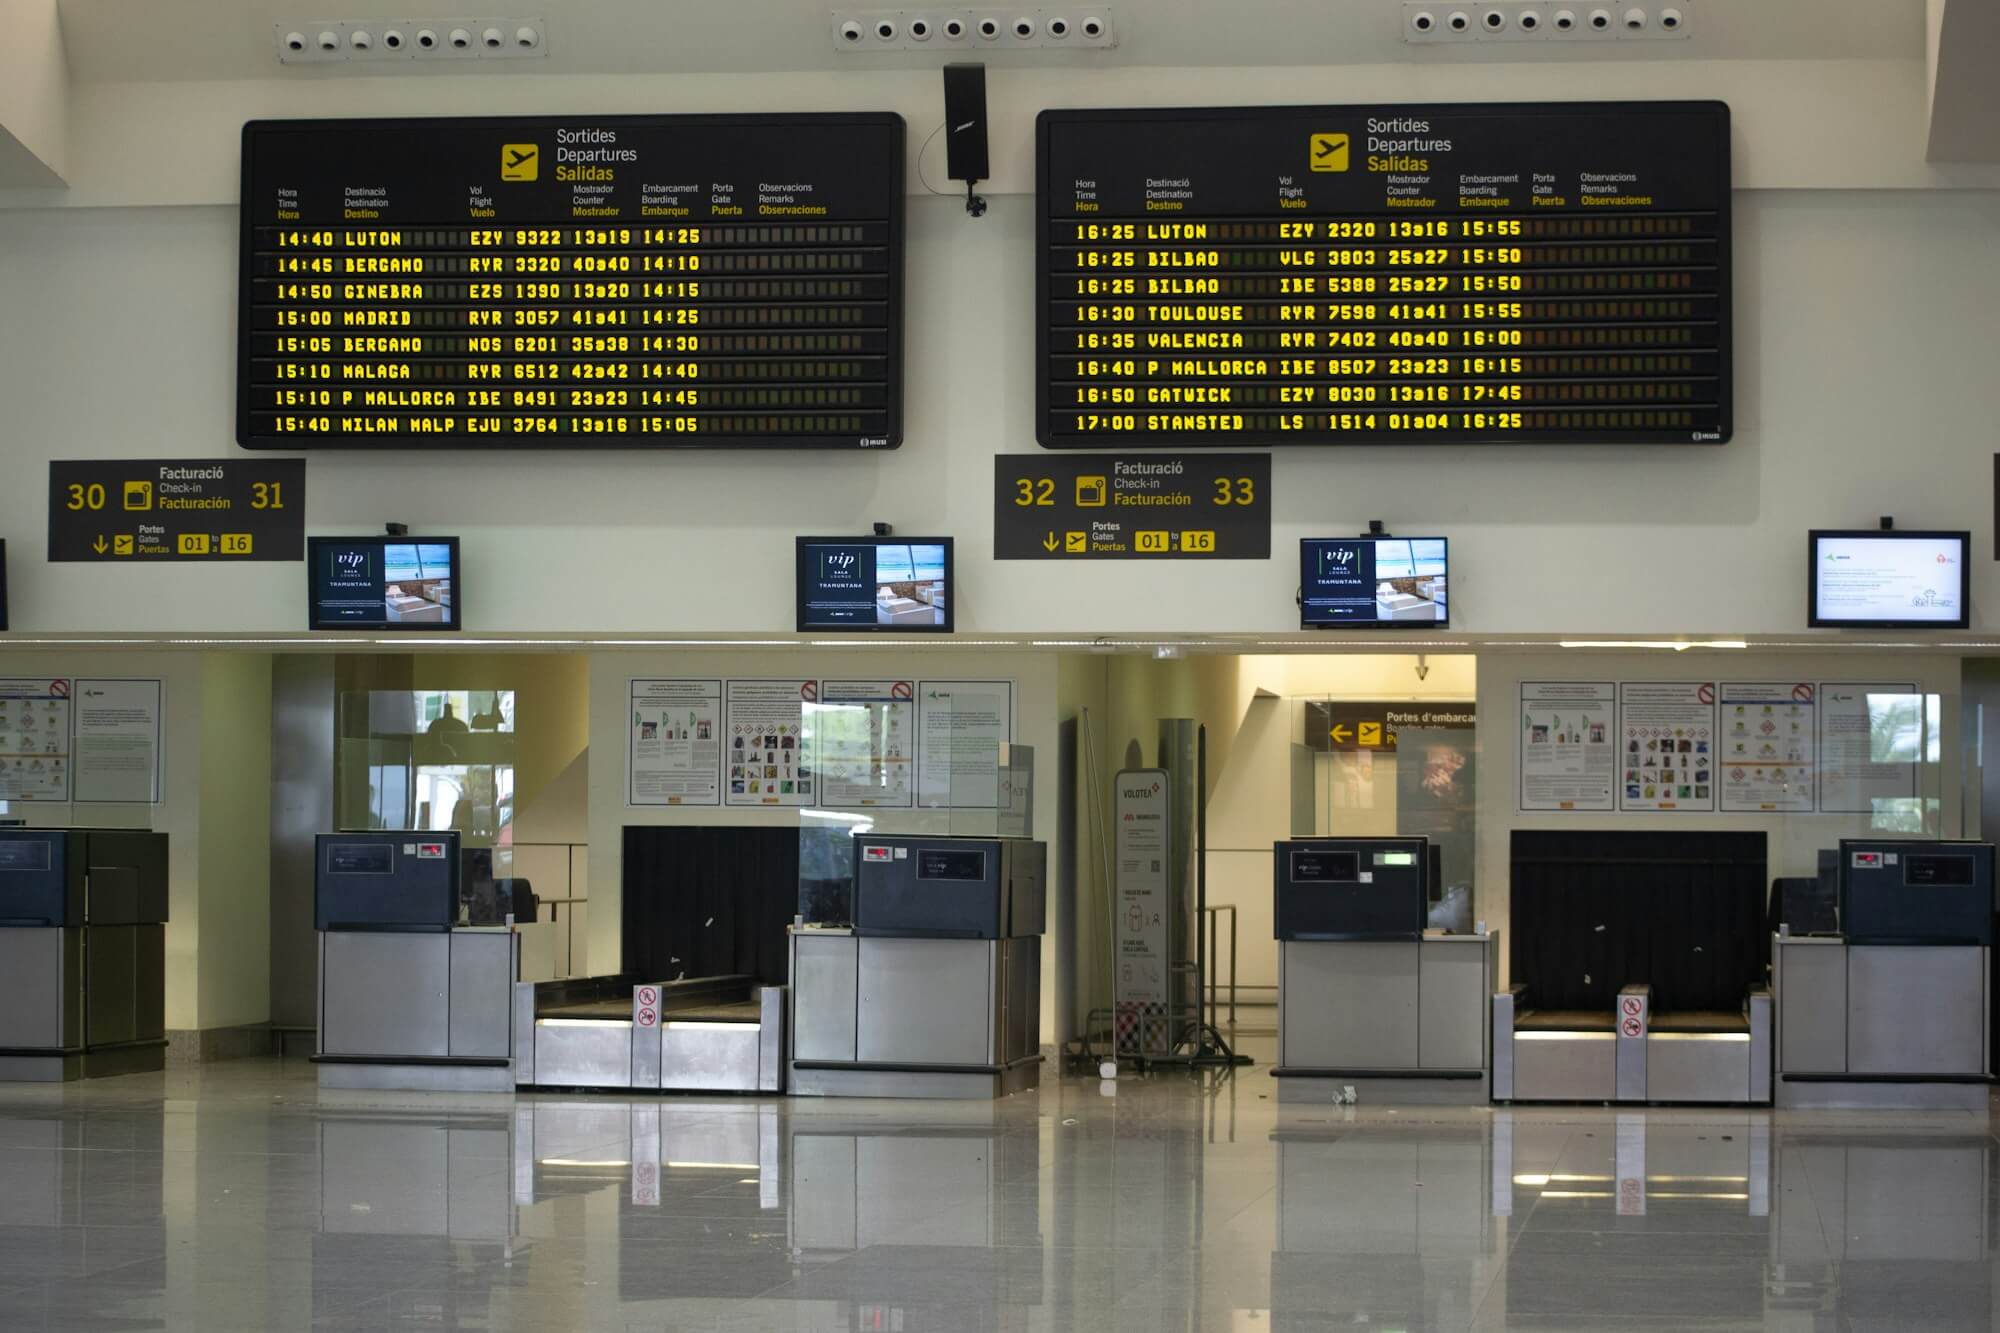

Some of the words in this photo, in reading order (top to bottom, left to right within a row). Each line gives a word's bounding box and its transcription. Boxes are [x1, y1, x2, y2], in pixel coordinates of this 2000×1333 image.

[1368, 118, 1429, 133] Sortides
[557, 129, 616, 143] Sortides
[1368, 137, 1452, 154] Departures
[557, 148, 637, 164] Departures
[1368, 156, 1430, 171] Salidas
[556, 166, 614, 181] Salidas
[345, 187, 386, 197] Destinació
[574, 185, 614, 194] Mostrador
[643, 184, 699, 193] Embarcament
[713, 184, 734, 193] Porta
[759, 183, 813, 192] Observacions
[345, 198, 389, 207] Destination
[573, 196, 604, 205] Counter
[642, 196, 678, 206] Boarding
[759, 194, 794, 203] Remarks
[278, 209, 300, 219] Hora
[345, 209, 379, 218] Destino
[470, 208, 495, 217] Vuelo
[573, 207, 620, 216] Mostrador
[642, 206, 689, 217] Embarque
[712, 205, 743, 215] Puerta
[759, 205, 827, 215] Observaciones
[279, 231, 333, 247] 14:40
[345, 231, 401, 247] LUTON
[470, 230, 503, 246] EZY
[516, 230, 561, 246] 9322
[575, 229, 630, 245] 13a19
[644, 228, 700, 244] 14:25
[1077, 224, 1135, 240] 16:25
[1147, 223, 1207, 240] LUTON
[1279, 223, 1314, 239] EZY
[1328, 222, 1376, 238] 2320
[1389, 221, 1448, 237] 13a16
[1462, 220, 1521, 236] 15:55
[279, 257, 333, 273] 14:45
[345, 257, 423, 273] BERGAMO
[469, 257, 503, 273] RYR
[515, 256, 561, 273] 3320
[573, 256, 630, 272] 40a40
[643, 255, 700, 271] 14:10
[1077, 251, 1135, 267] 16:25
[1148, 251, 1219, 267] BILBAO
[1280, 250, 1315, 266] VLG
[1328, 249, 1376, 266] 3803
[1388, 249, 1449, 265] 25a27
[1462, 248, 1522, 264] 15:50
[278, 284, 332, 299] 14:50
[344, 284, 423, 300] GINEBRA
[469, 283, 503, 299] EZS
[516, 283, 560, 299] 1390
[574, 282, 630, 299] 13a20
[643, 282, 699, 298] 14:15
[1077, 278, 1135, 294] 16:25
[1148, 278, 1219, 294] BILBAO
[1280, 277, 1316, 293] IBE
[1328, 277, 1376, 293] 5388
[1389, 276, 1449, 293] 25a27
[1462, 275, 1522, 292] 15:50
[277, 310, 332, 326] 15:00
[343, 310, 411, 326] MADRID
[468, 310, 502, 325] RYR
[514, 310, 560, 326] 3057
[572, 309, 626, 325] 41a41
[643, 309, 699, 325] 14:25
[1077, 305, 1135, 322] 16:30
[1148, 305, 1243, 321] TOULOUSE
[1280, 305, 1316, 321] RYR
[1328, 304, 1376, 320] 7598
[1389, 304, 1446, 320] 41a41
[1463, 303, 1522, 319] 15:55
[277, 337, 331, 353] 15:05
[343, 337, 422, 353] BERGAMO
[468, 337, 502, 353] NOS
[514, 336, 556, 353] 6201
[571, 336, 629, 352] 35a38
[642, 336, 698, 352] 14:30
[1077, 333, 1135, 349] 16:35
[1147, 332, 1243, 349] VALENCIA
[1280, 332, 1316, 348] RYR
[1328, 331, 1376, 347] 7402
[1389, 330, 1449, 347] 40a40
[1463, 330, 1522, 346] 16:00
[277, 364, 331, 379] 15:10
[343, 364, 410, 379] MALAGA
[468, 364, 502, 379] RYR
[513, 363, 559, 379] 6512
[571, 363, 628, 379] 42a42
[642, 363, 698, 379] 14:40
[1077, 360, 1135, 376] 16:40
[1147, 360, 1159, 376] P
[1171, 360, 1267, 376] MALLORCA
[1280, 359, 1316, 375] IBE
[1328, 359, 1376, 375] 8507
[1388, 358, 1449, 375] 23a23
[1463, 357, 1522, 374] 16:15
[276, 390, 330, 406] 15:10
[342, 390, 353, 405] P
[365, 390, 455, 406] MALLORCA
[467, 391, 501, 406] IBE
[513, 391, 556, 406] 8491
[571, 390, 628, 406] 23a23
[642, 390, 698, 406] 14:45
[1077, 387, 1135, 403] 16:50
[1147, 387, 1231, 403] GATWICK
[1280, 387, 1315, 403] EZY
[1328, 386, 1376, 402] 8030
[1390, 385, 1449, 402] 13a16
[1463, 385, 1522, 401] 17:45
[276, 417, 330, 432] 15:40
[342, 417, 398, 433] MILAN
[410, 417, 455, 433] MALP
[467, 417, 501, 433] EJU
[513, 417, 558, 433] 3764
[571, 417, 628, 433] 13a16
[641, 417, 698, 433] 15:05
[1077, 415, 1135, 431] 17:00
[1147, 415, 1243, 431] STANSTED
[1280, 414, 1304, 430] LS
[1329, 414, 1376, 430] 1514
[1389, 413, 1449, 430] 01a04
[1463, 413, 1522, 429] 16:25
[160, 467, 223, 480] Facturació
[1114, 462, 1183, 475] Facturació
[160, 483, 202, 493] Check-in
[1114, 478, 1160, 489] Check-in
[67, 484, 106, 510] 30
[251, 482, 284, 508] 31
[1015, 479, 1056, 506] 32
[1114, 492, 1191, 506] Facturación
[1213, 478, 1254, 506] 33
[160, 497, 231, 510] Facturación
[139, 525, 165, 534] Portes
[1092, 522, 1120, 531] Portes
[139, 535, 160, 544] Gates
[184, 537, 204, 551] 01
[227, 537, 247, 551] 16
[1092, 532, 1114, 541] Gates
[1142, 534, 1162, 549] 01
[1188, 534, 1209, 549] 16
[139, 545, 170, 554] Puertas
[1092, 542, 1126, 552] Puertas
[338, 551, 364, 567] vip
[828, 552, 855, 568] vip
[1326, 548, 1354, 564] vip
[1387, 712, 1418, 722] Portes
